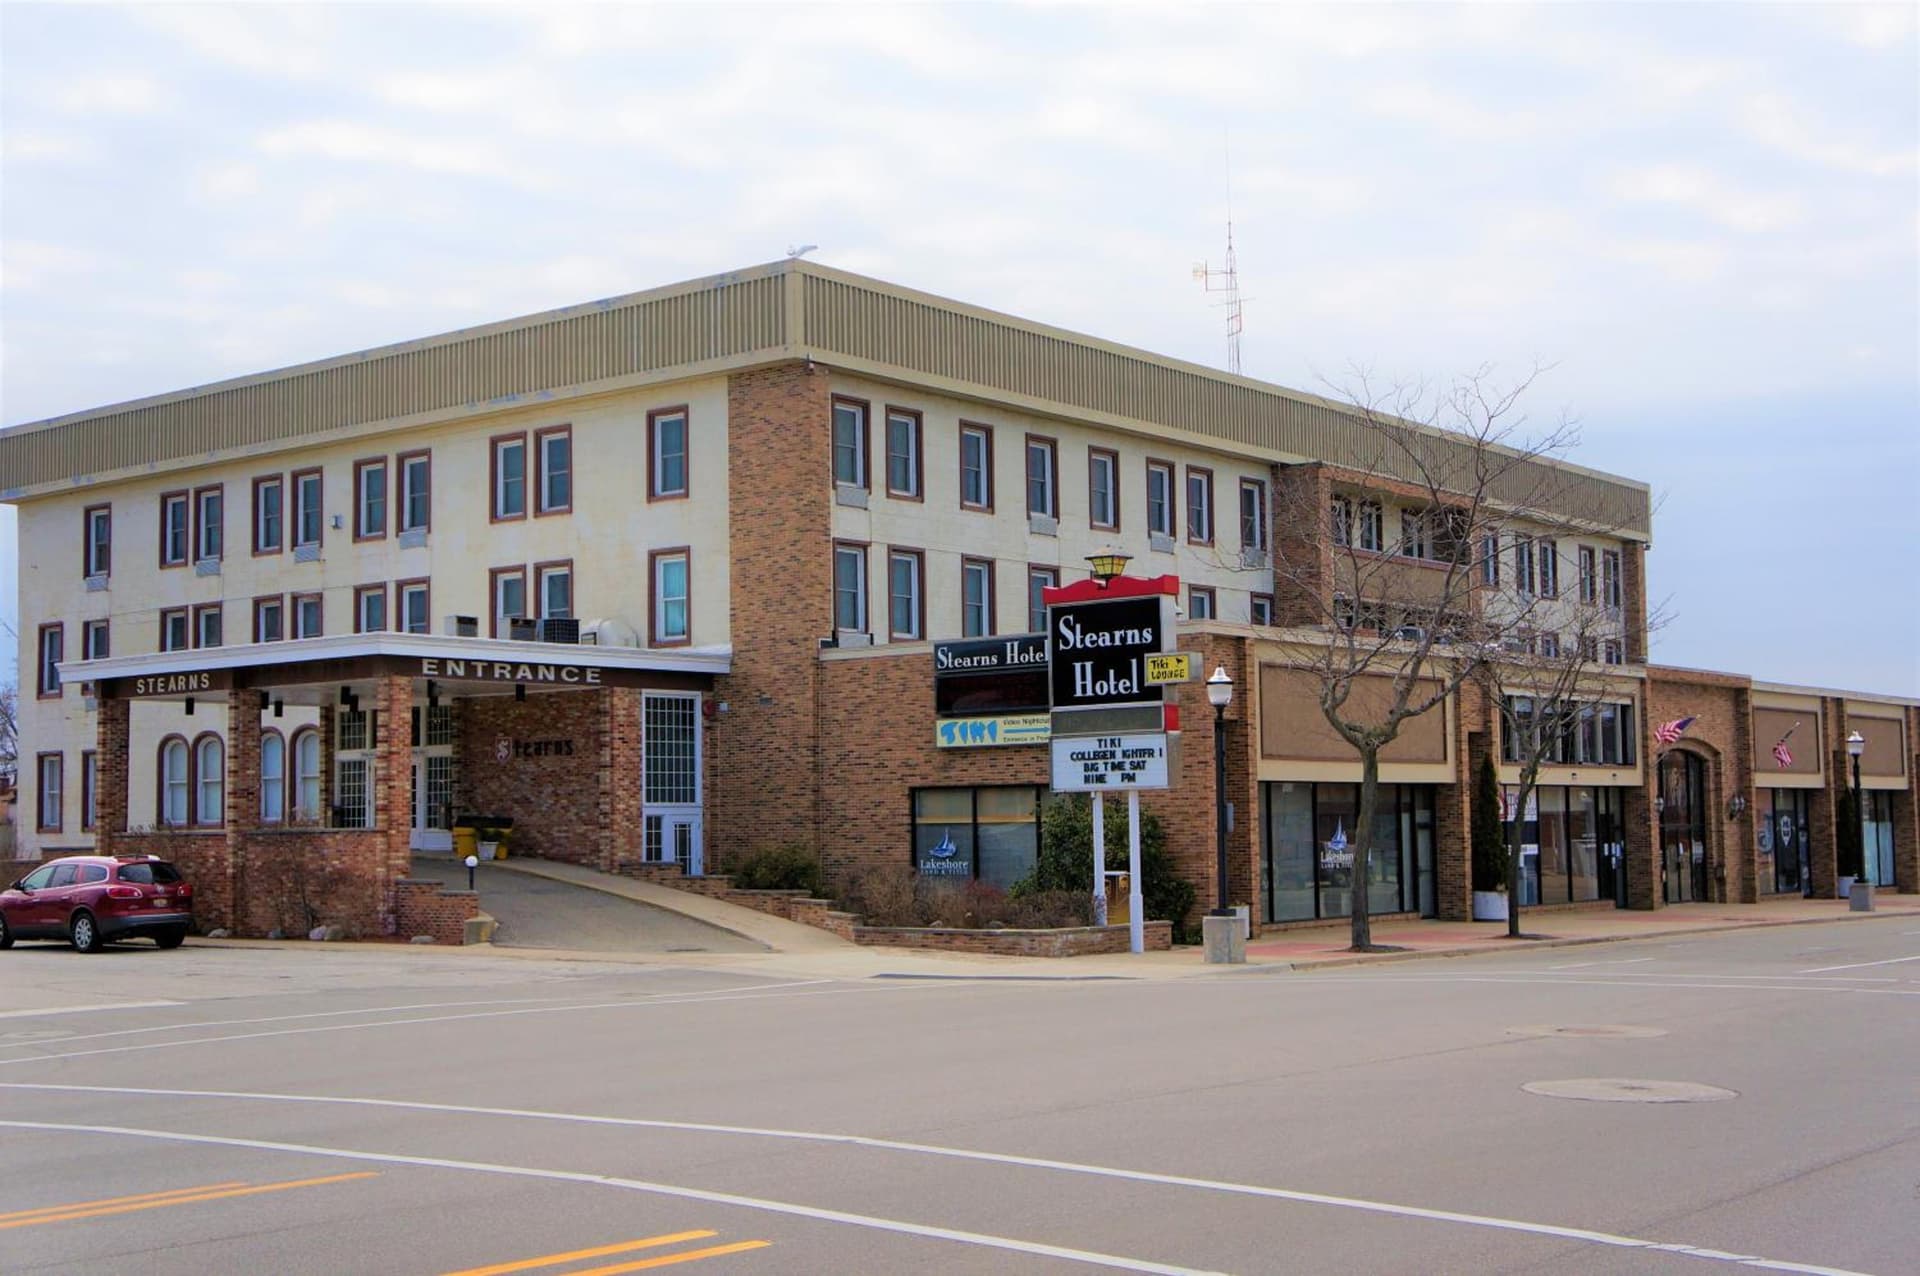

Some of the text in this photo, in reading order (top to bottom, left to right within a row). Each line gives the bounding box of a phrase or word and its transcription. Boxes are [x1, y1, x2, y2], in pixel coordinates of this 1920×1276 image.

[1058, 614, 1153, 651] Stearns
[937, 640, 1049, 669] Stearns Hotel
[421, 658, 602, 683] ENTRANCE
[1072, 658, 1140, 697] Hotel
[1151, 669, 1185, 680] LOUNGE
[136, 673, 210, 694] STEARNS
[1097, 738, 1121, 749] TIKI
[1083, 762, 1099, 772] BIG
[1129, 760, 1147, 770] SAT
[1084, 772, 1136, 784] NINE PM
[920, 858, 969, 869] Lakeshore
